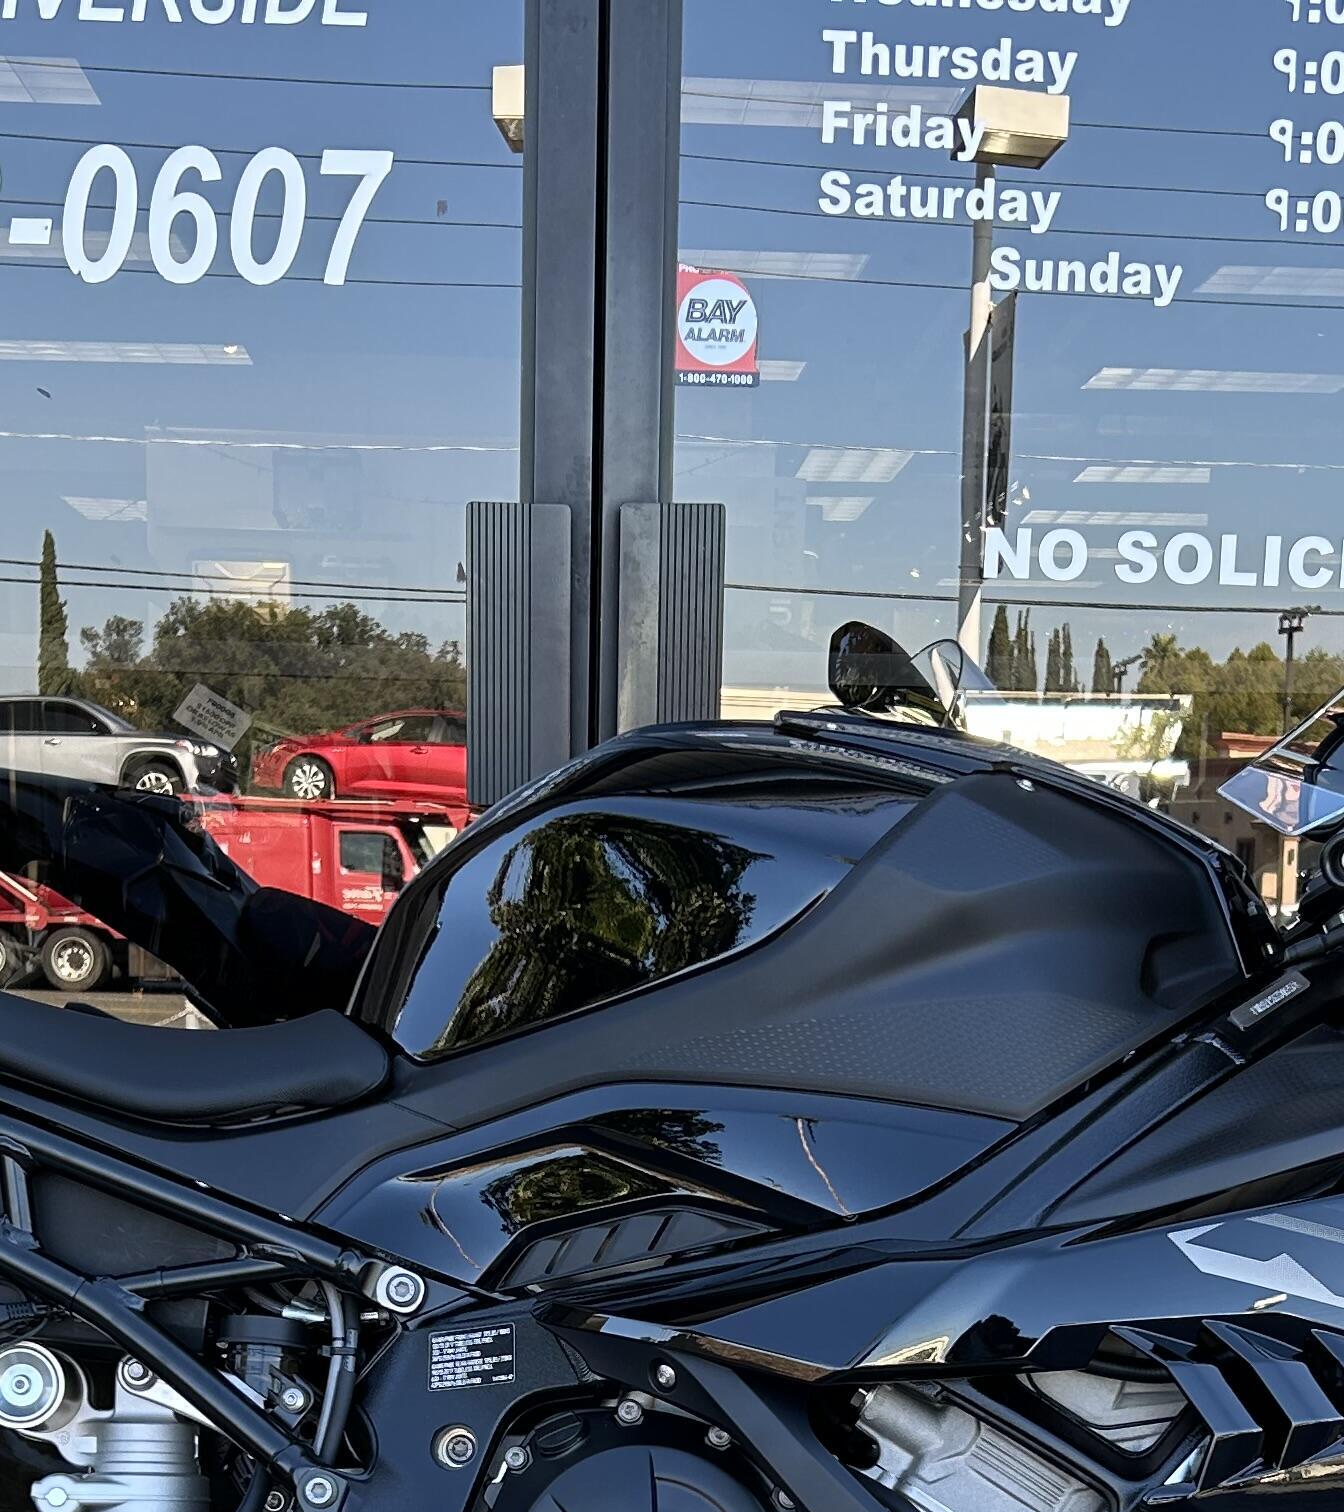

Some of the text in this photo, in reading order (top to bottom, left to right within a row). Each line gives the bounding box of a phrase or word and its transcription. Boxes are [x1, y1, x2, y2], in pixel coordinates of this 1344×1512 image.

[822, 29, 1079, 94] Thursday
[821, 101, 986, 162] Friday
[818, 170, 1062, 234] Saturday
[989, 246, 1184, 307] Sunday
[684, 327, 746, 343] ALARM
[685, 298, 748, 325] BAY
[983, 527, 1089, 581] NO
